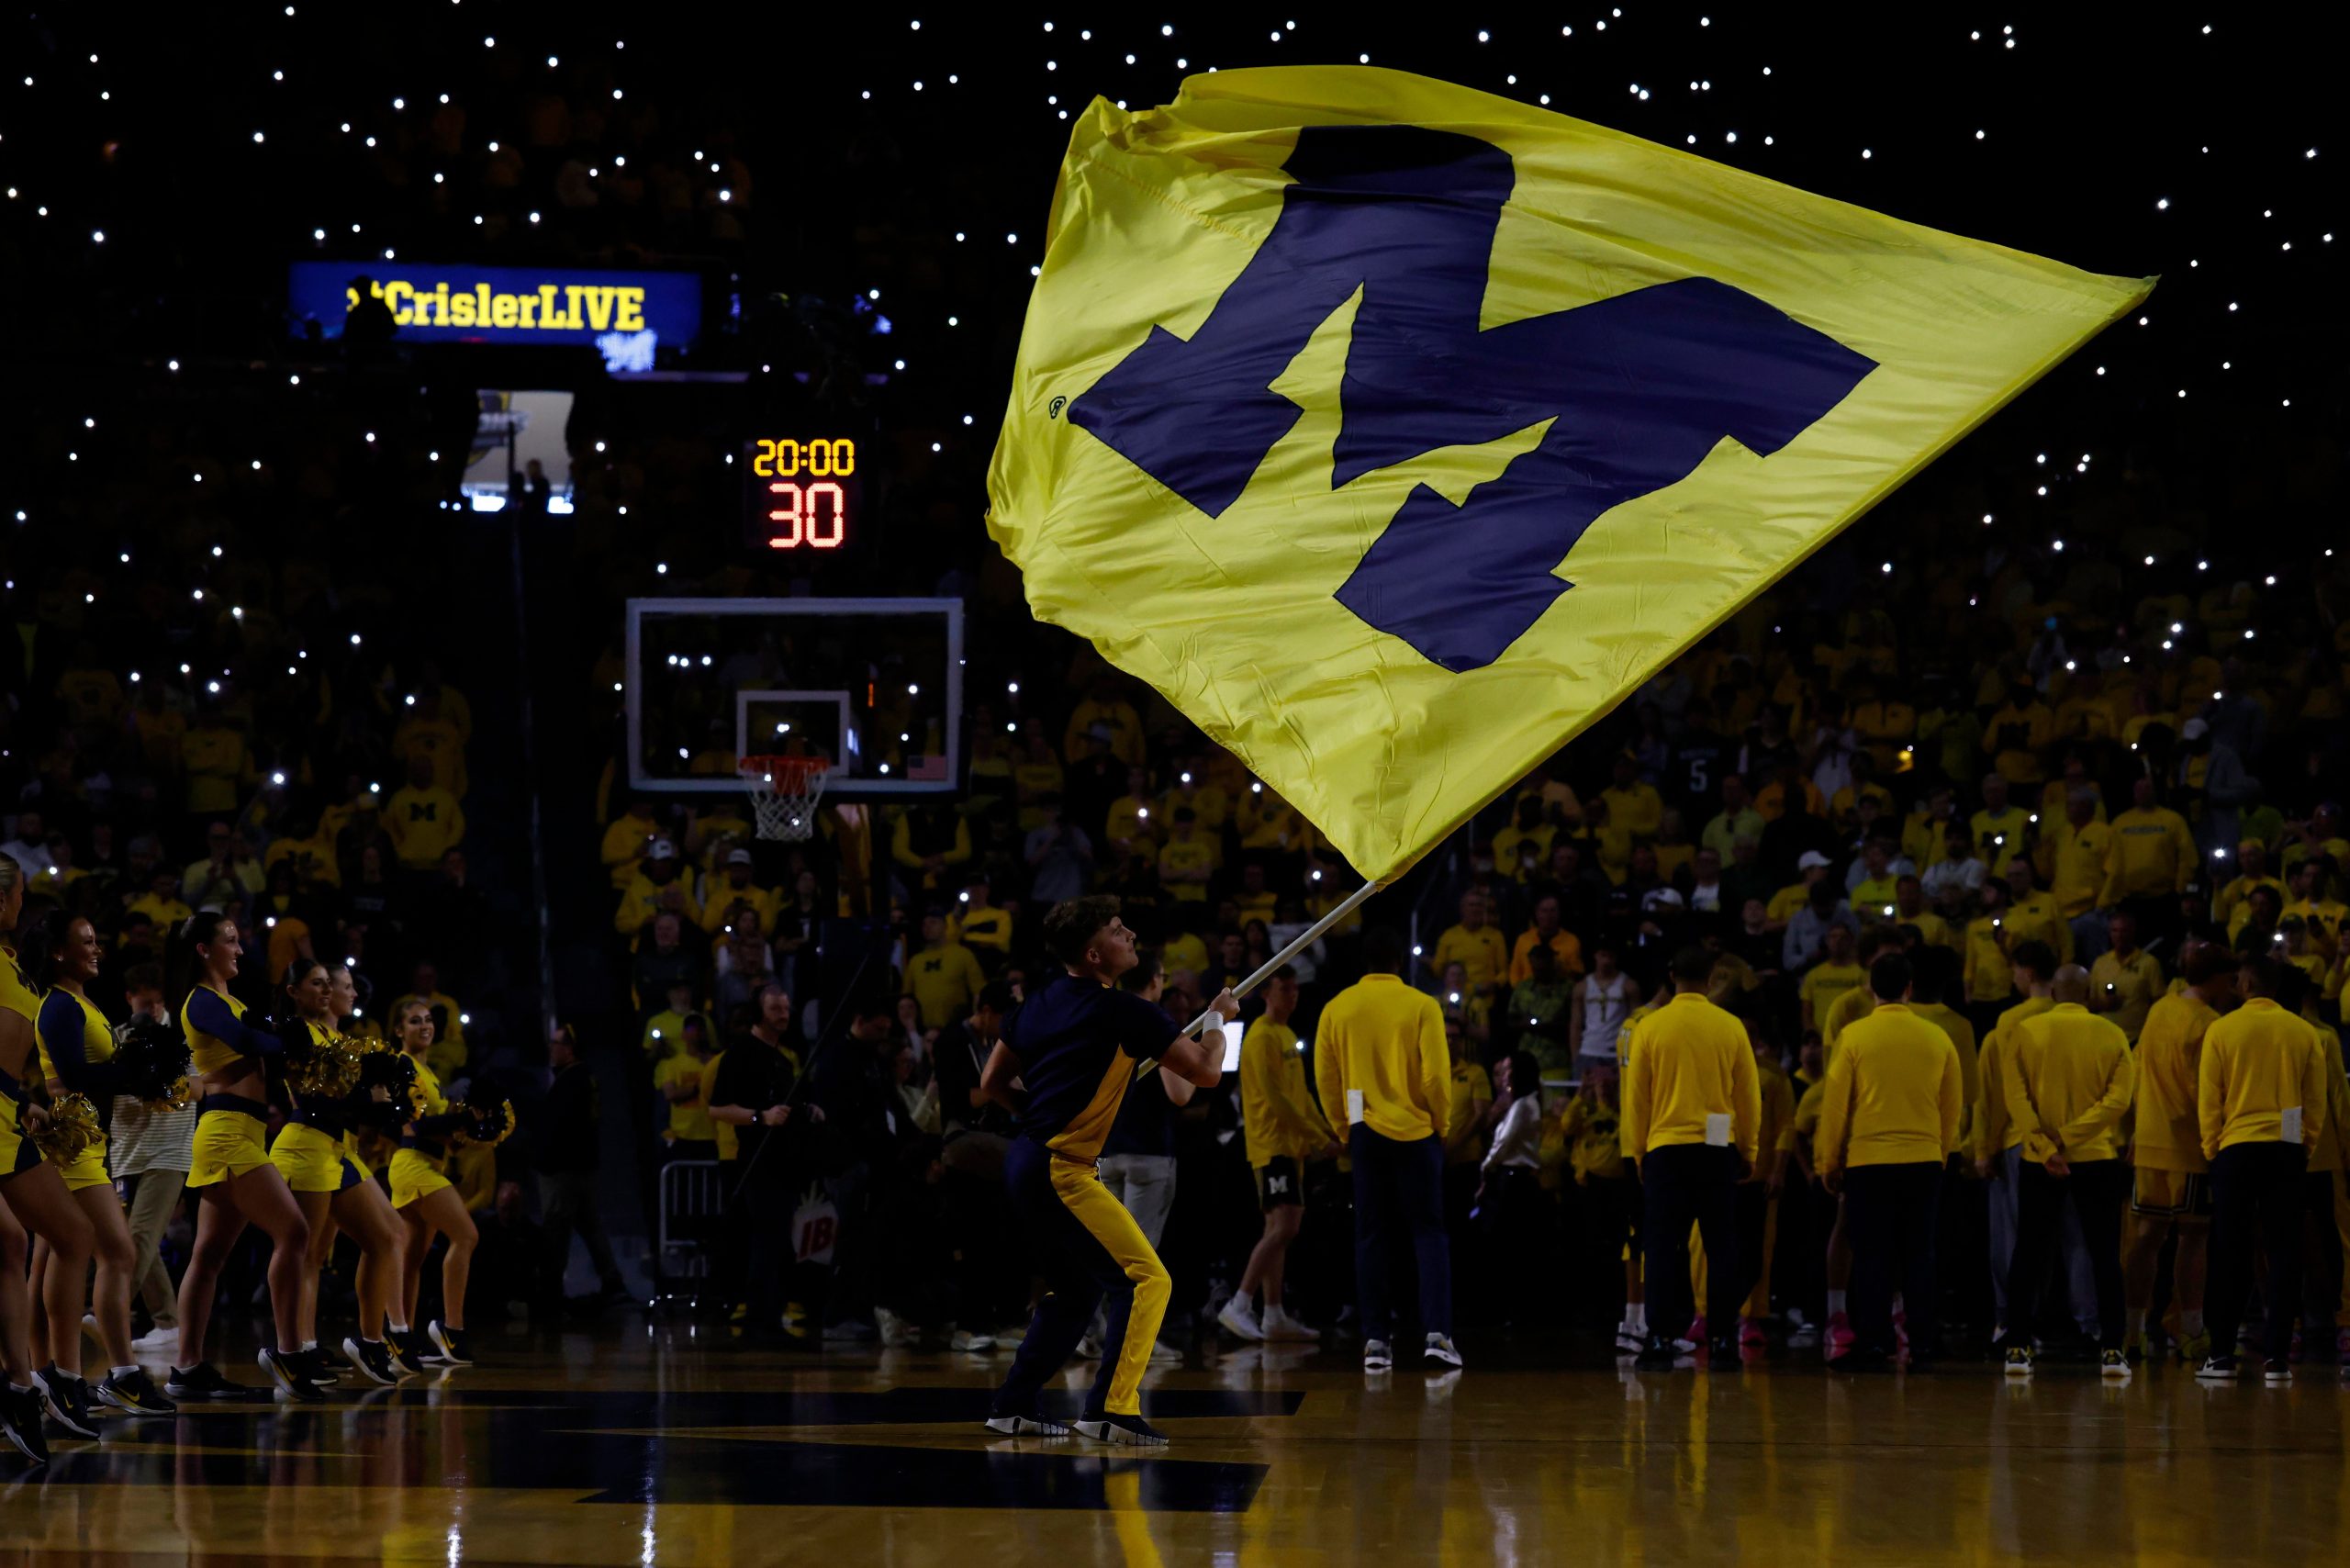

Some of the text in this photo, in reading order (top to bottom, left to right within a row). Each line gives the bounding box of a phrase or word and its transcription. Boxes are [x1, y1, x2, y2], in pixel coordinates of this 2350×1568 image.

[346, 280, 645, 331] CrislerLIVE
[754, 439, 855, 476] 20:00
[769, 482, 844, 548] 30
[1689, 759, 1708, 793] 5
[410, 803, 436, 822] M
[1268, 1175, 1289, 1195] M
